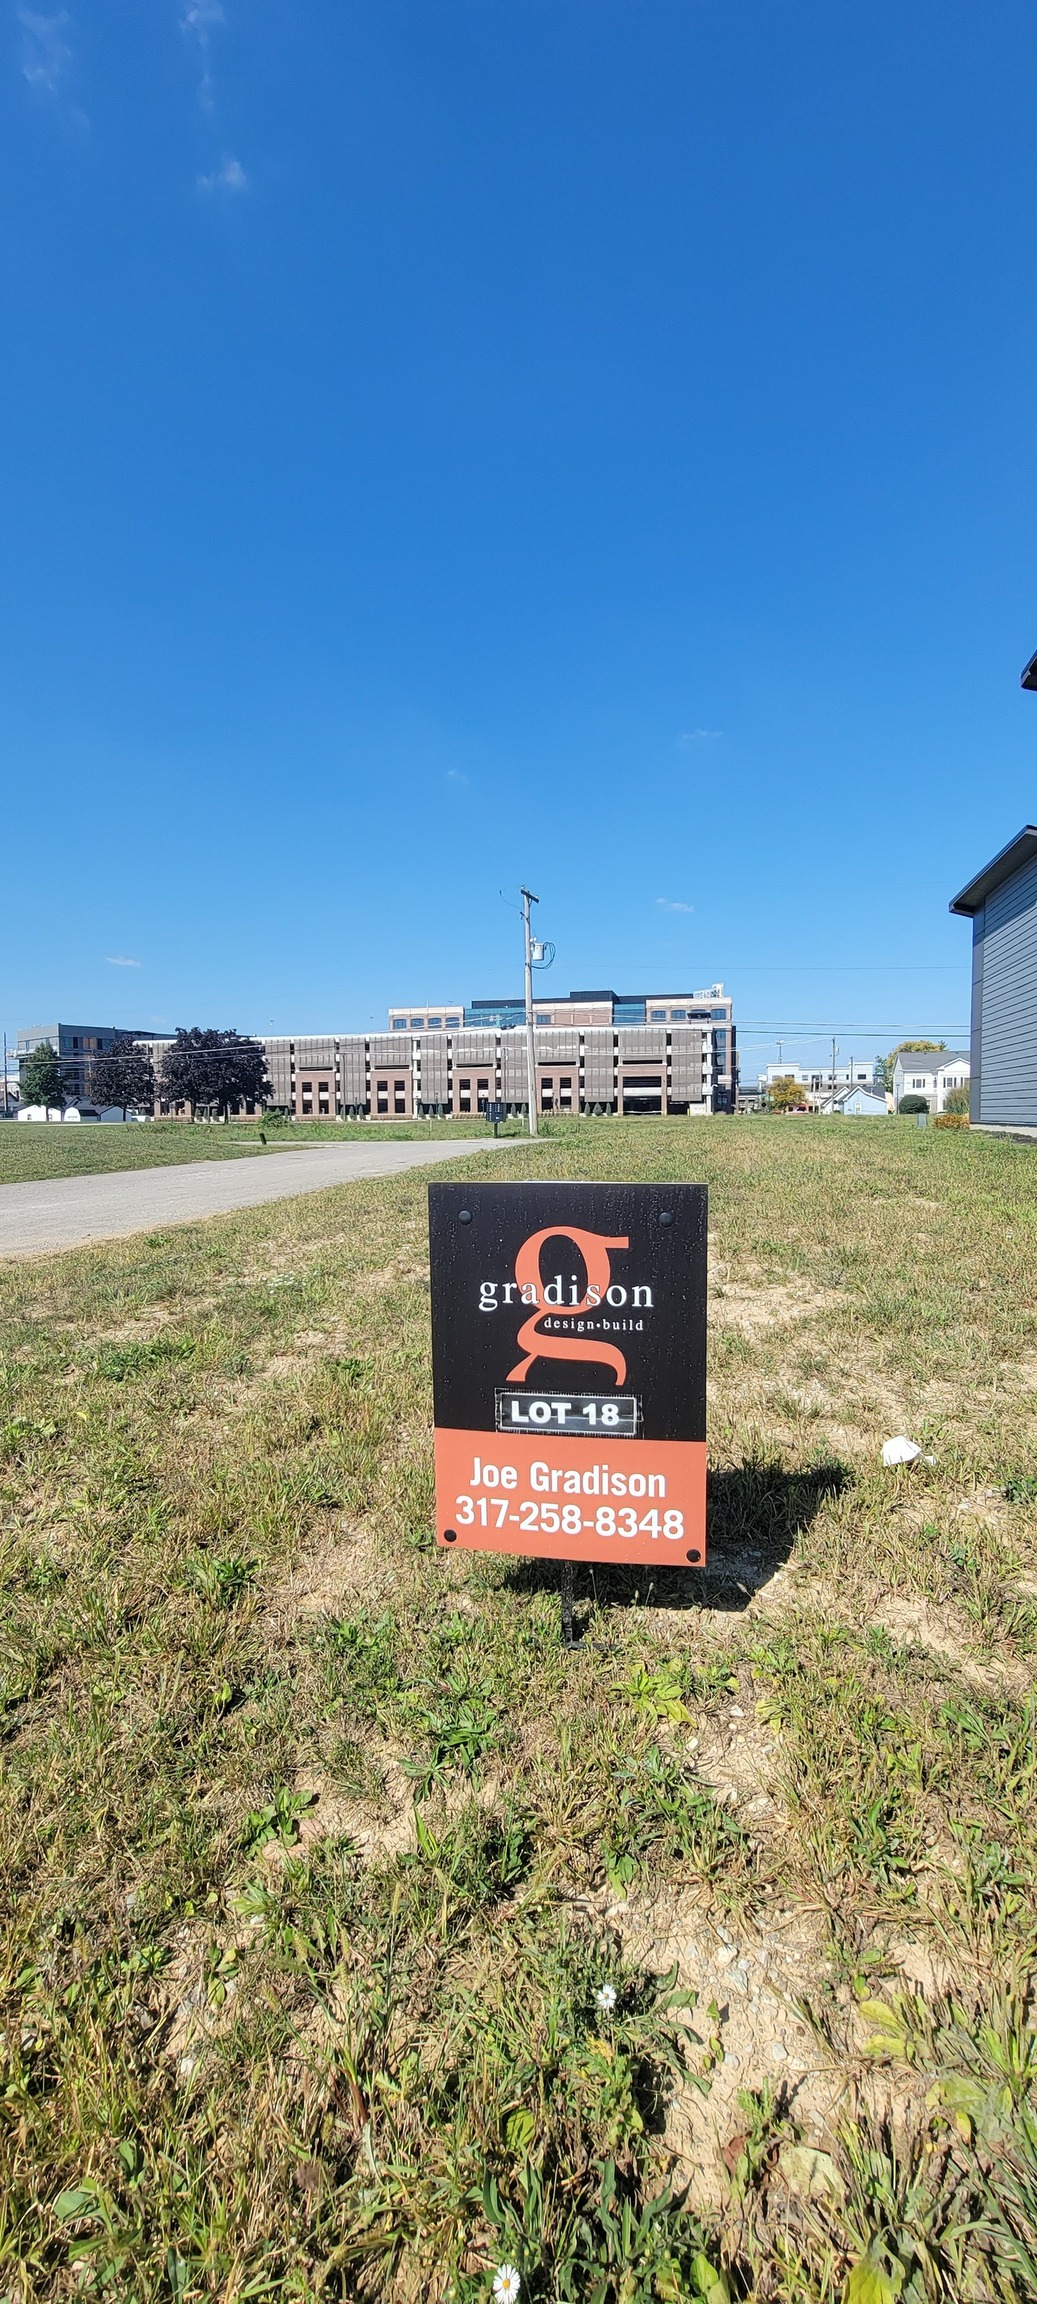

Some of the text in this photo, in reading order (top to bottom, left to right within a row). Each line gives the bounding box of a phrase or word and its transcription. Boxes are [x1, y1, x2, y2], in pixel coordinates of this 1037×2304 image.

[478, 1274, 654, 1312] gradison
[510, 1400, 620, 1427] LOT 18
[469, 1456, 667, 1499] Joe Gradison
[455, 1494, 685, 1540] 317-258-8348
